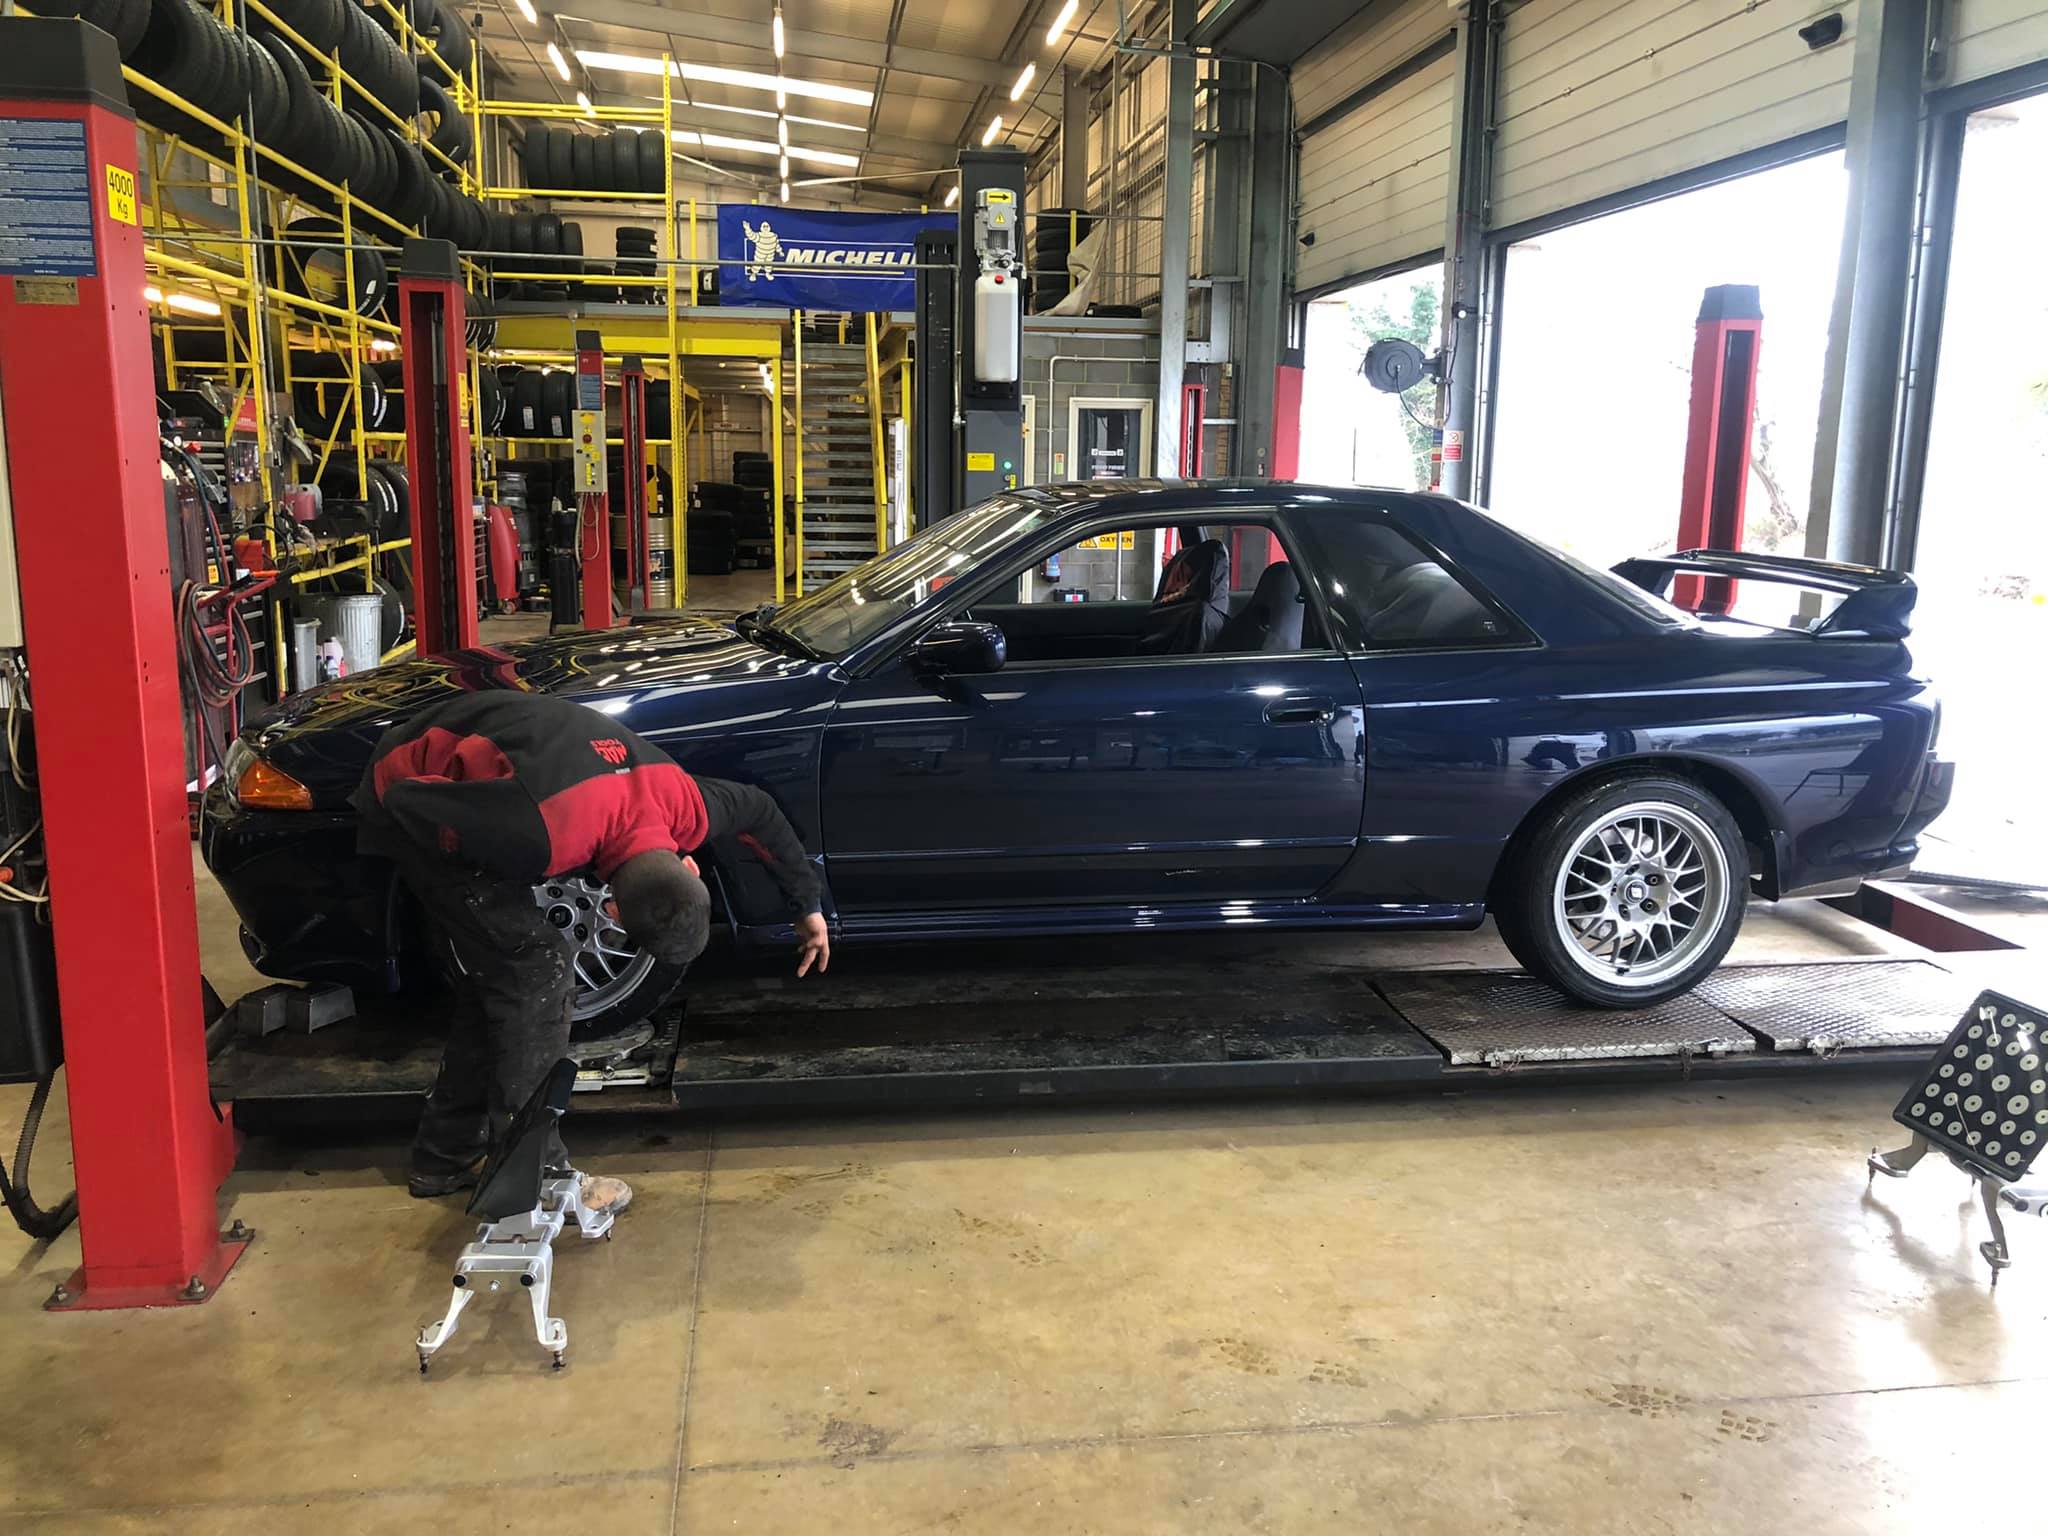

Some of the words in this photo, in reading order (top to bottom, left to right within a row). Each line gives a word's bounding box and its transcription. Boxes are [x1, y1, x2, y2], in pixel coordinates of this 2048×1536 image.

[109, 171, 134, 198] 4000
[117, 199, 129, 219] Kg
[785, 248, 917, 265] MICHELI
